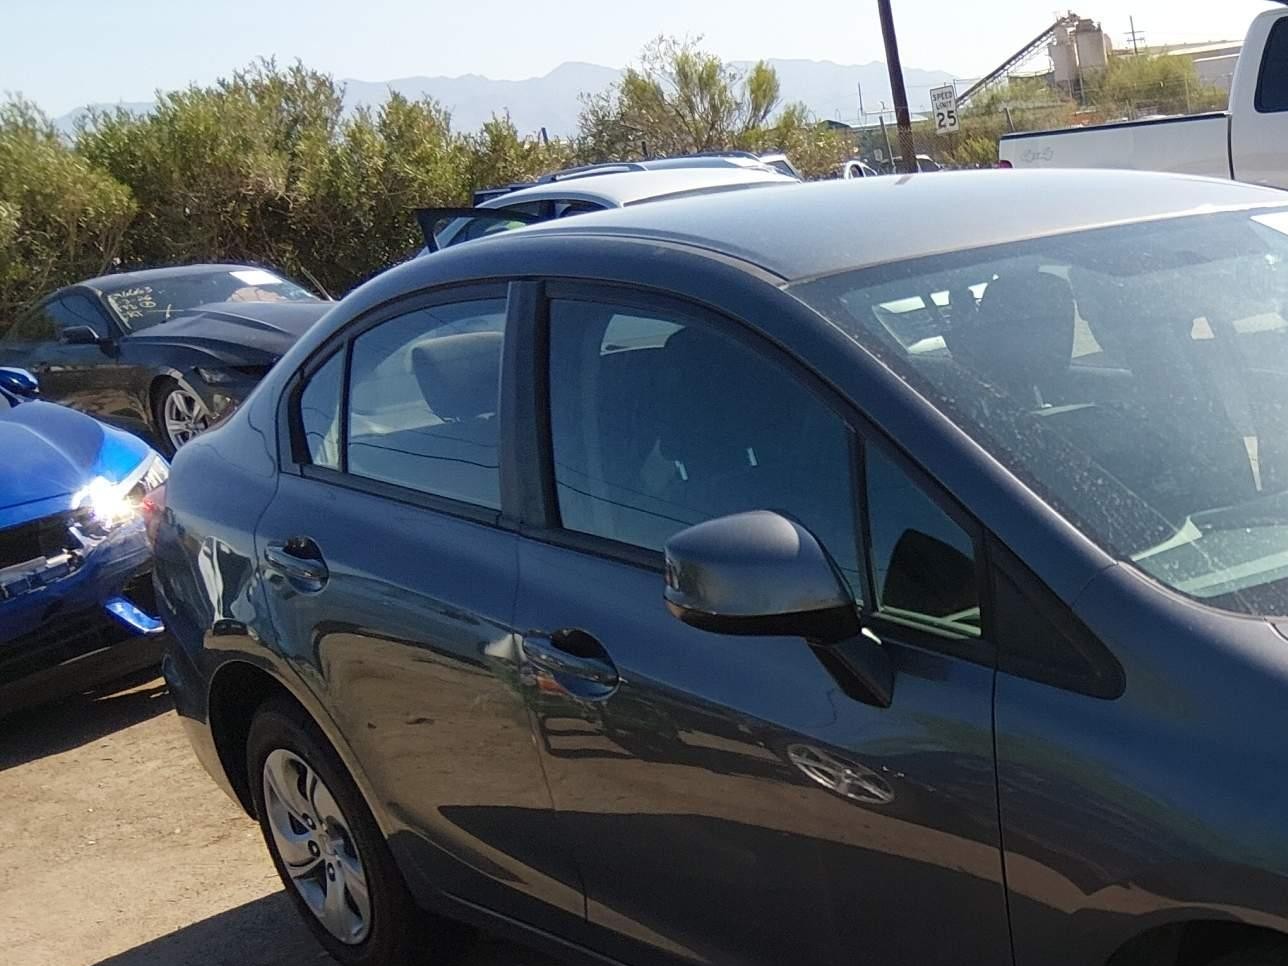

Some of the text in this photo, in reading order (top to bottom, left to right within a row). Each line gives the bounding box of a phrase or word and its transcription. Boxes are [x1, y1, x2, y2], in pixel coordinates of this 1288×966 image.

[932, 91, 953, 101] SPEED
[936, 100, 952, 110] LIMIT
[936, 110, 957, 128] 25
